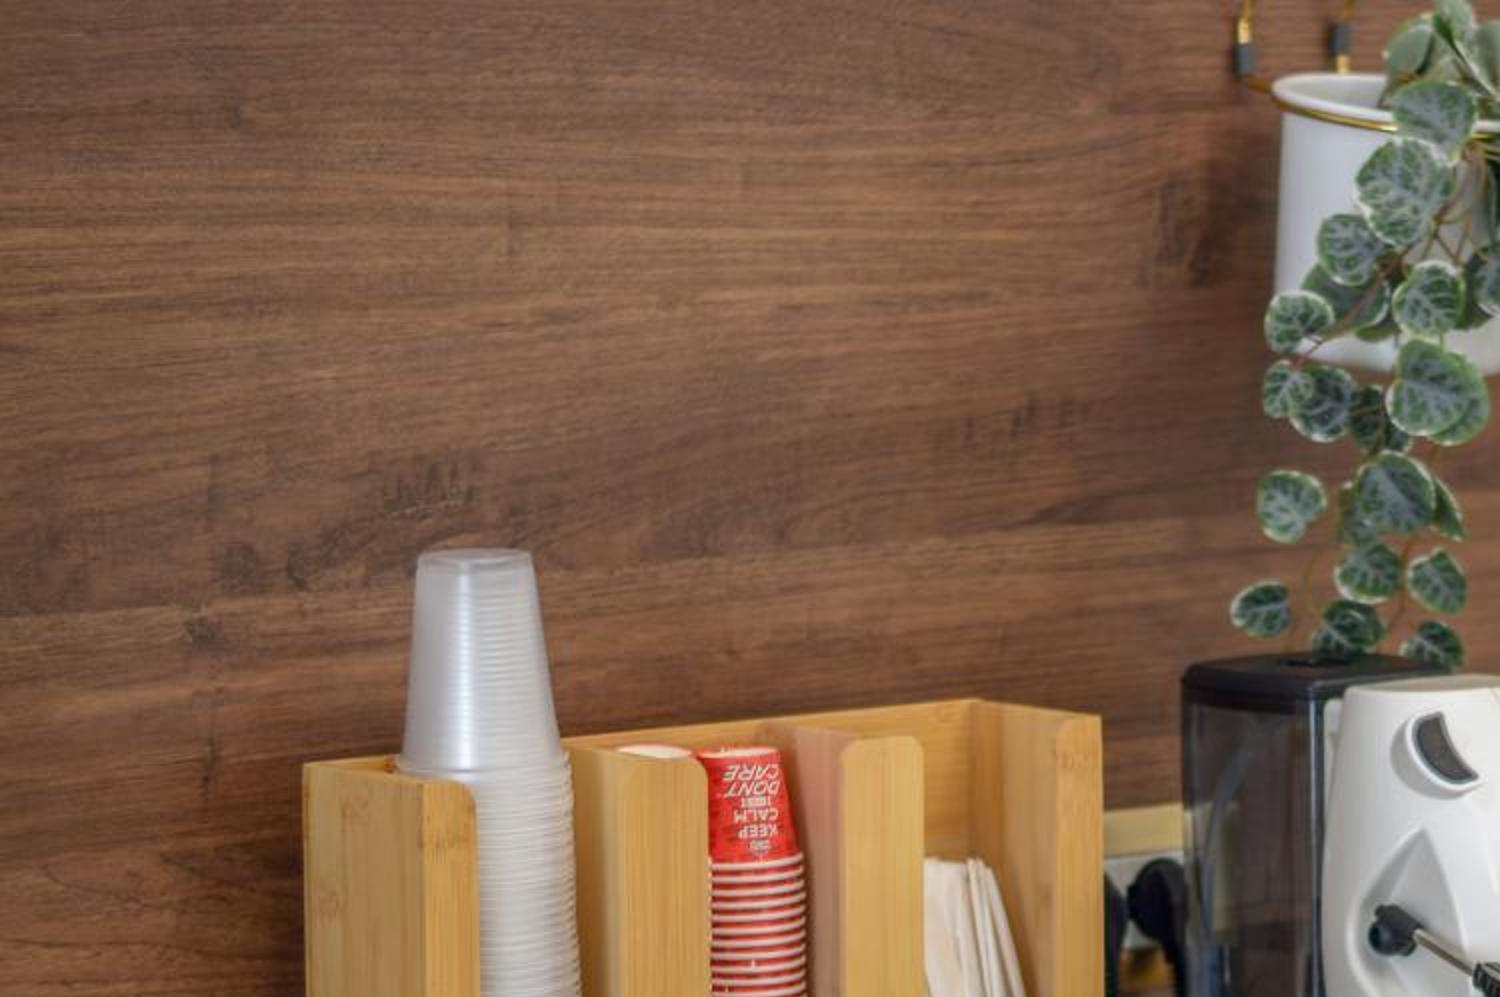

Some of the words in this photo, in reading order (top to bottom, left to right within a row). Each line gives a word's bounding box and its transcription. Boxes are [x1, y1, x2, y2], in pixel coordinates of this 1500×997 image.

[721, 763, 780, 781] CARE
[733, 807, 779, 824] CALM
[737, 823, 778, 839] KEEP
